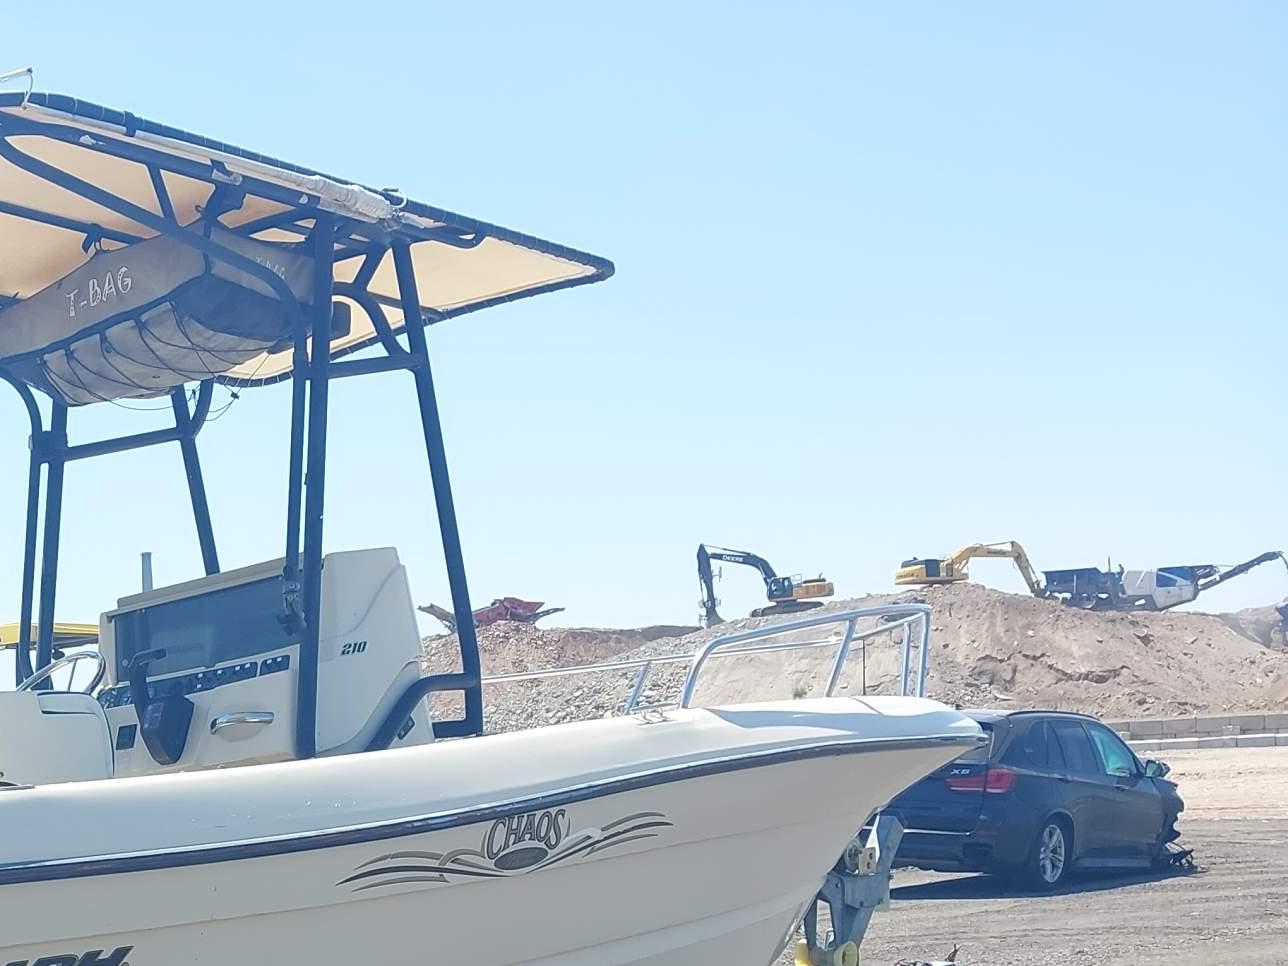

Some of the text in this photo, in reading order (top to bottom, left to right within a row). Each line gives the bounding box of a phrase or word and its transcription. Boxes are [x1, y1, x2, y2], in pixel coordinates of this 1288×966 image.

[64, 266, 132, 317] T-BAG
[341, 641, 368, 656] 210
[487, 808, 566, 860] CHAOS
